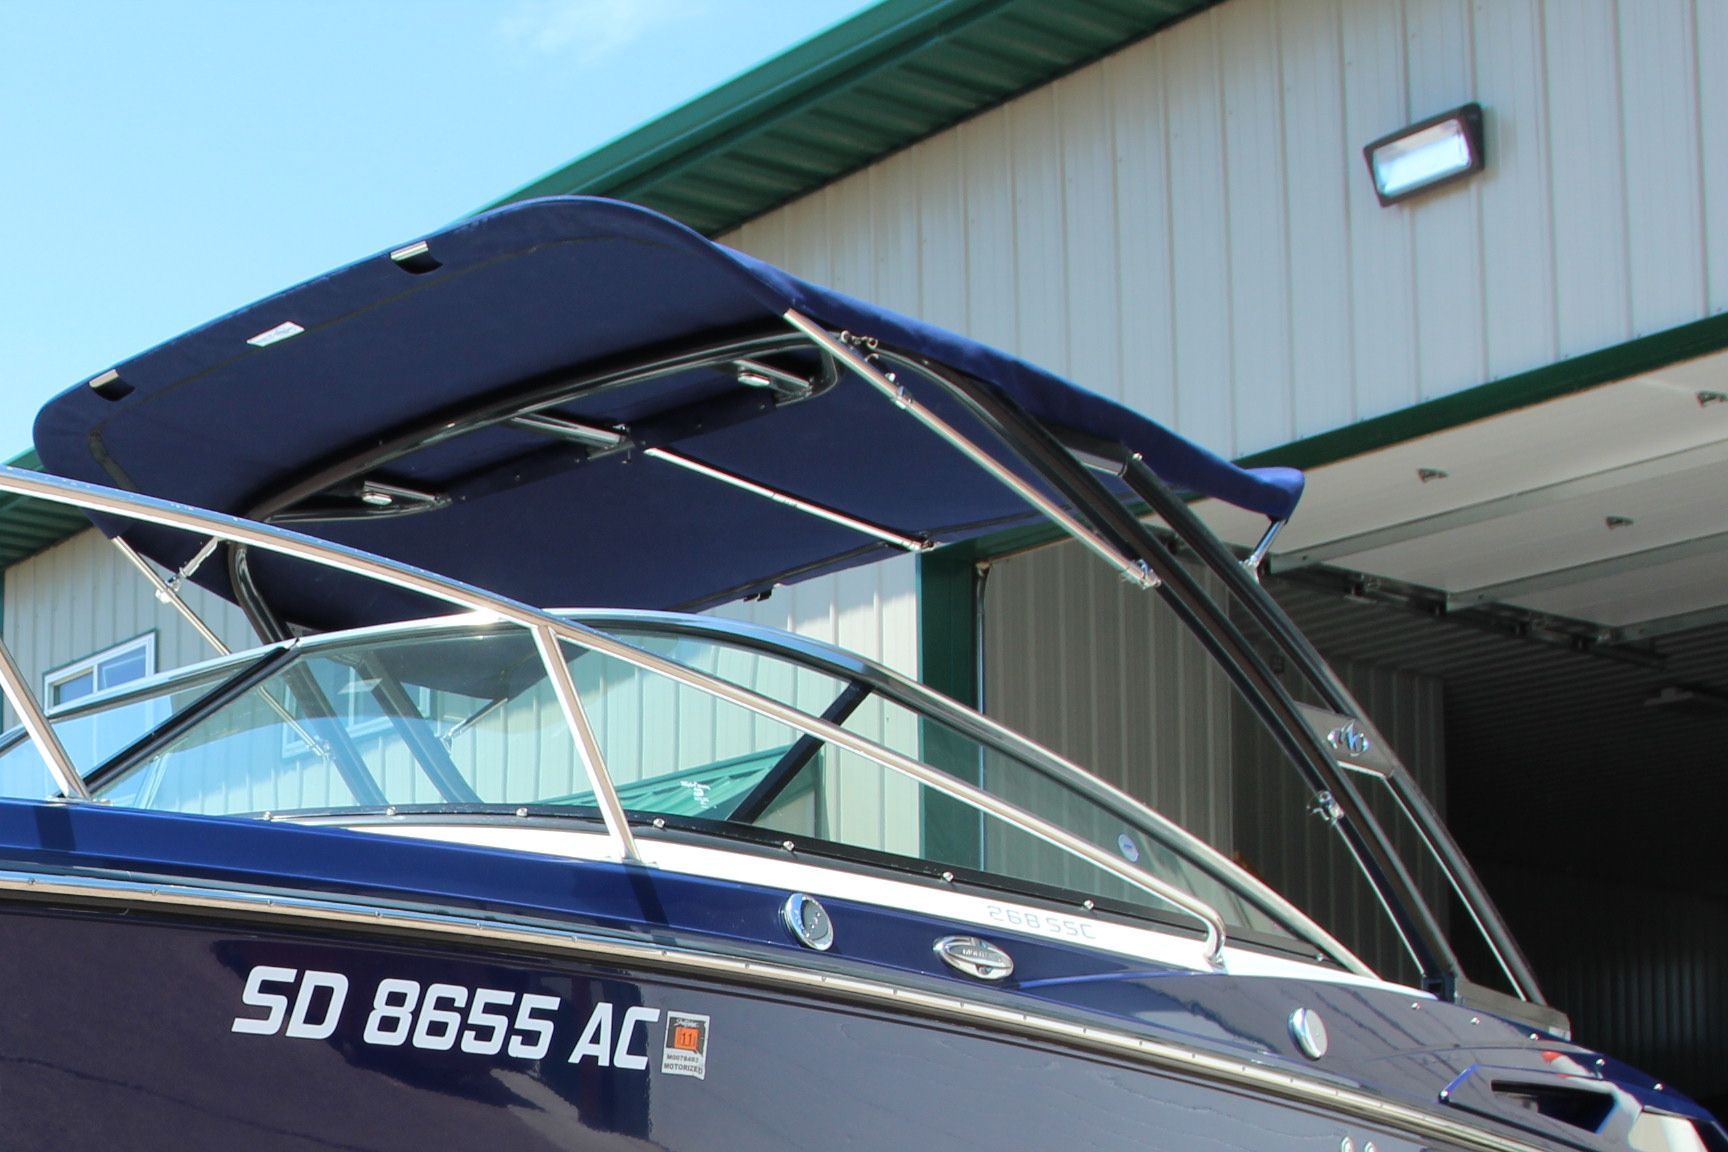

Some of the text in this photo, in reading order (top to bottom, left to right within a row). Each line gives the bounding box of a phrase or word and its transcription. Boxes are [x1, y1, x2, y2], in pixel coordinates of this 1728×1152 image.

[231, 965, 661, 1070] SD 8655 AC
[664, 1063, 703, 1074] MOTORIZED
